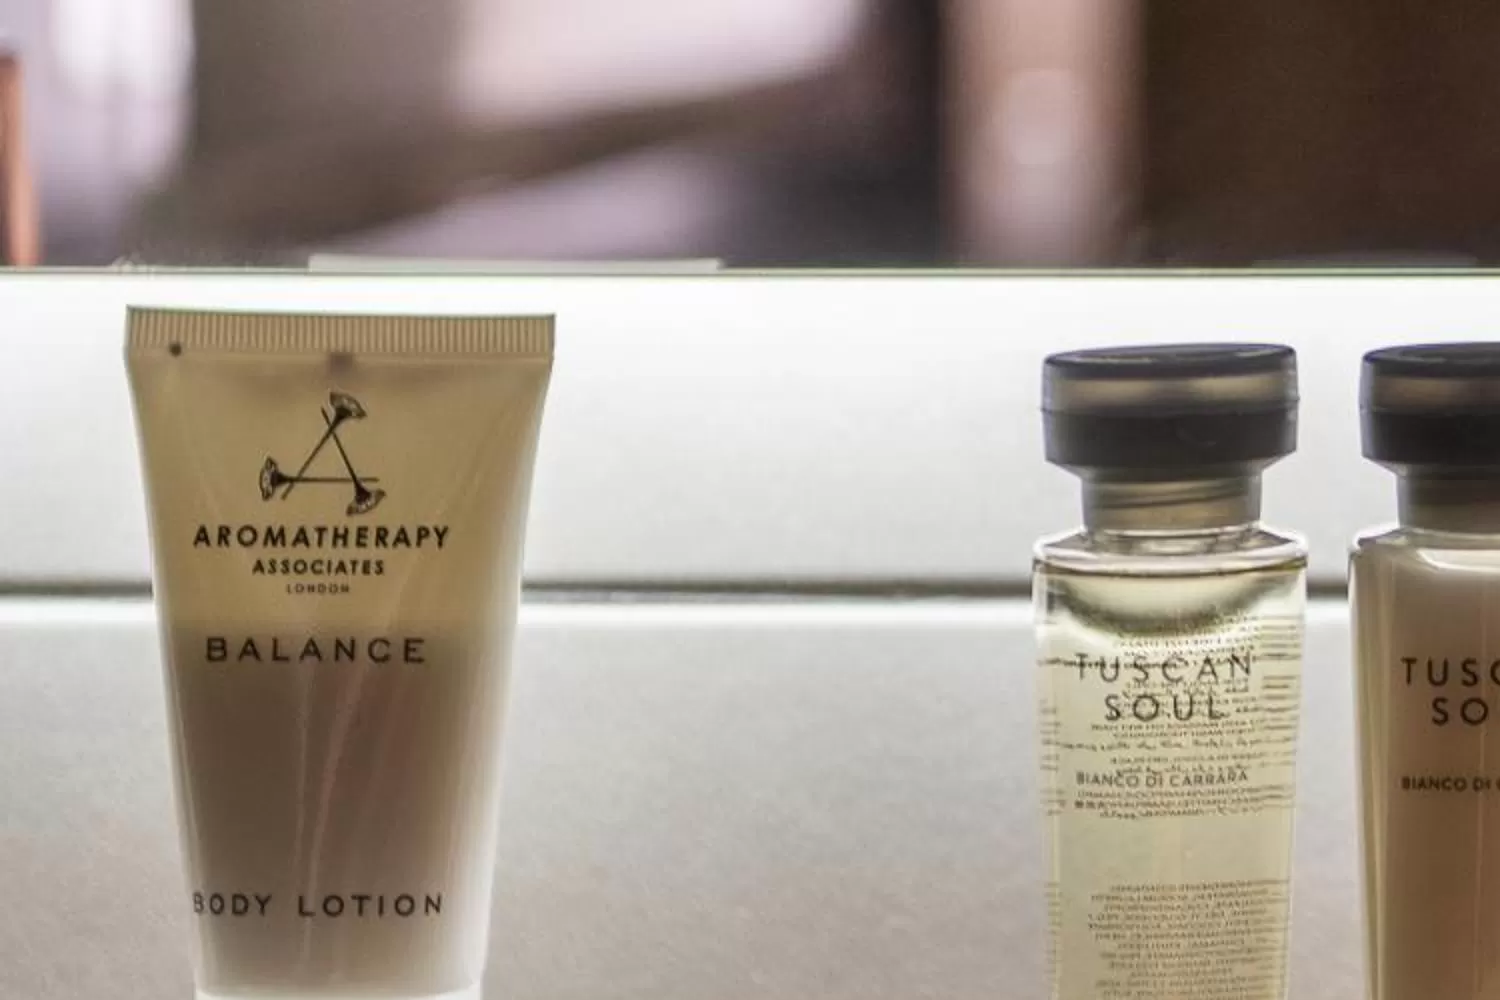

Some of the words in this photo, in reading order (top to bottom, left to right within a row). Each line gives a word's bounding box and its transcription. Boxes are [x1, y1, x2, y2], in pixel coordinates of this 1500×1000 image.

[193, 524, 449, 549] AROMATHERAPY
[252, 559, 385, 576] ASSOCIATES
[286, 583, 351, 594] LONDON
[205, 636, 425, 664] BALANCE
[1075, 653, 1252, 683] TUSCAN
[1104, 694, 1228, 721] SOUL
[1076, 771, 1140, 788] BIANCO
[1145, 775, 1164, 787] DI
[1169, 770, 1249, 787] CARRARA
[1402, 775, 1467, 792] BIANCO
[1472, 776, 1491, 792] DI
[193, 891, 272, 917] BODY
[298, 892, 442, 918] LOTION
